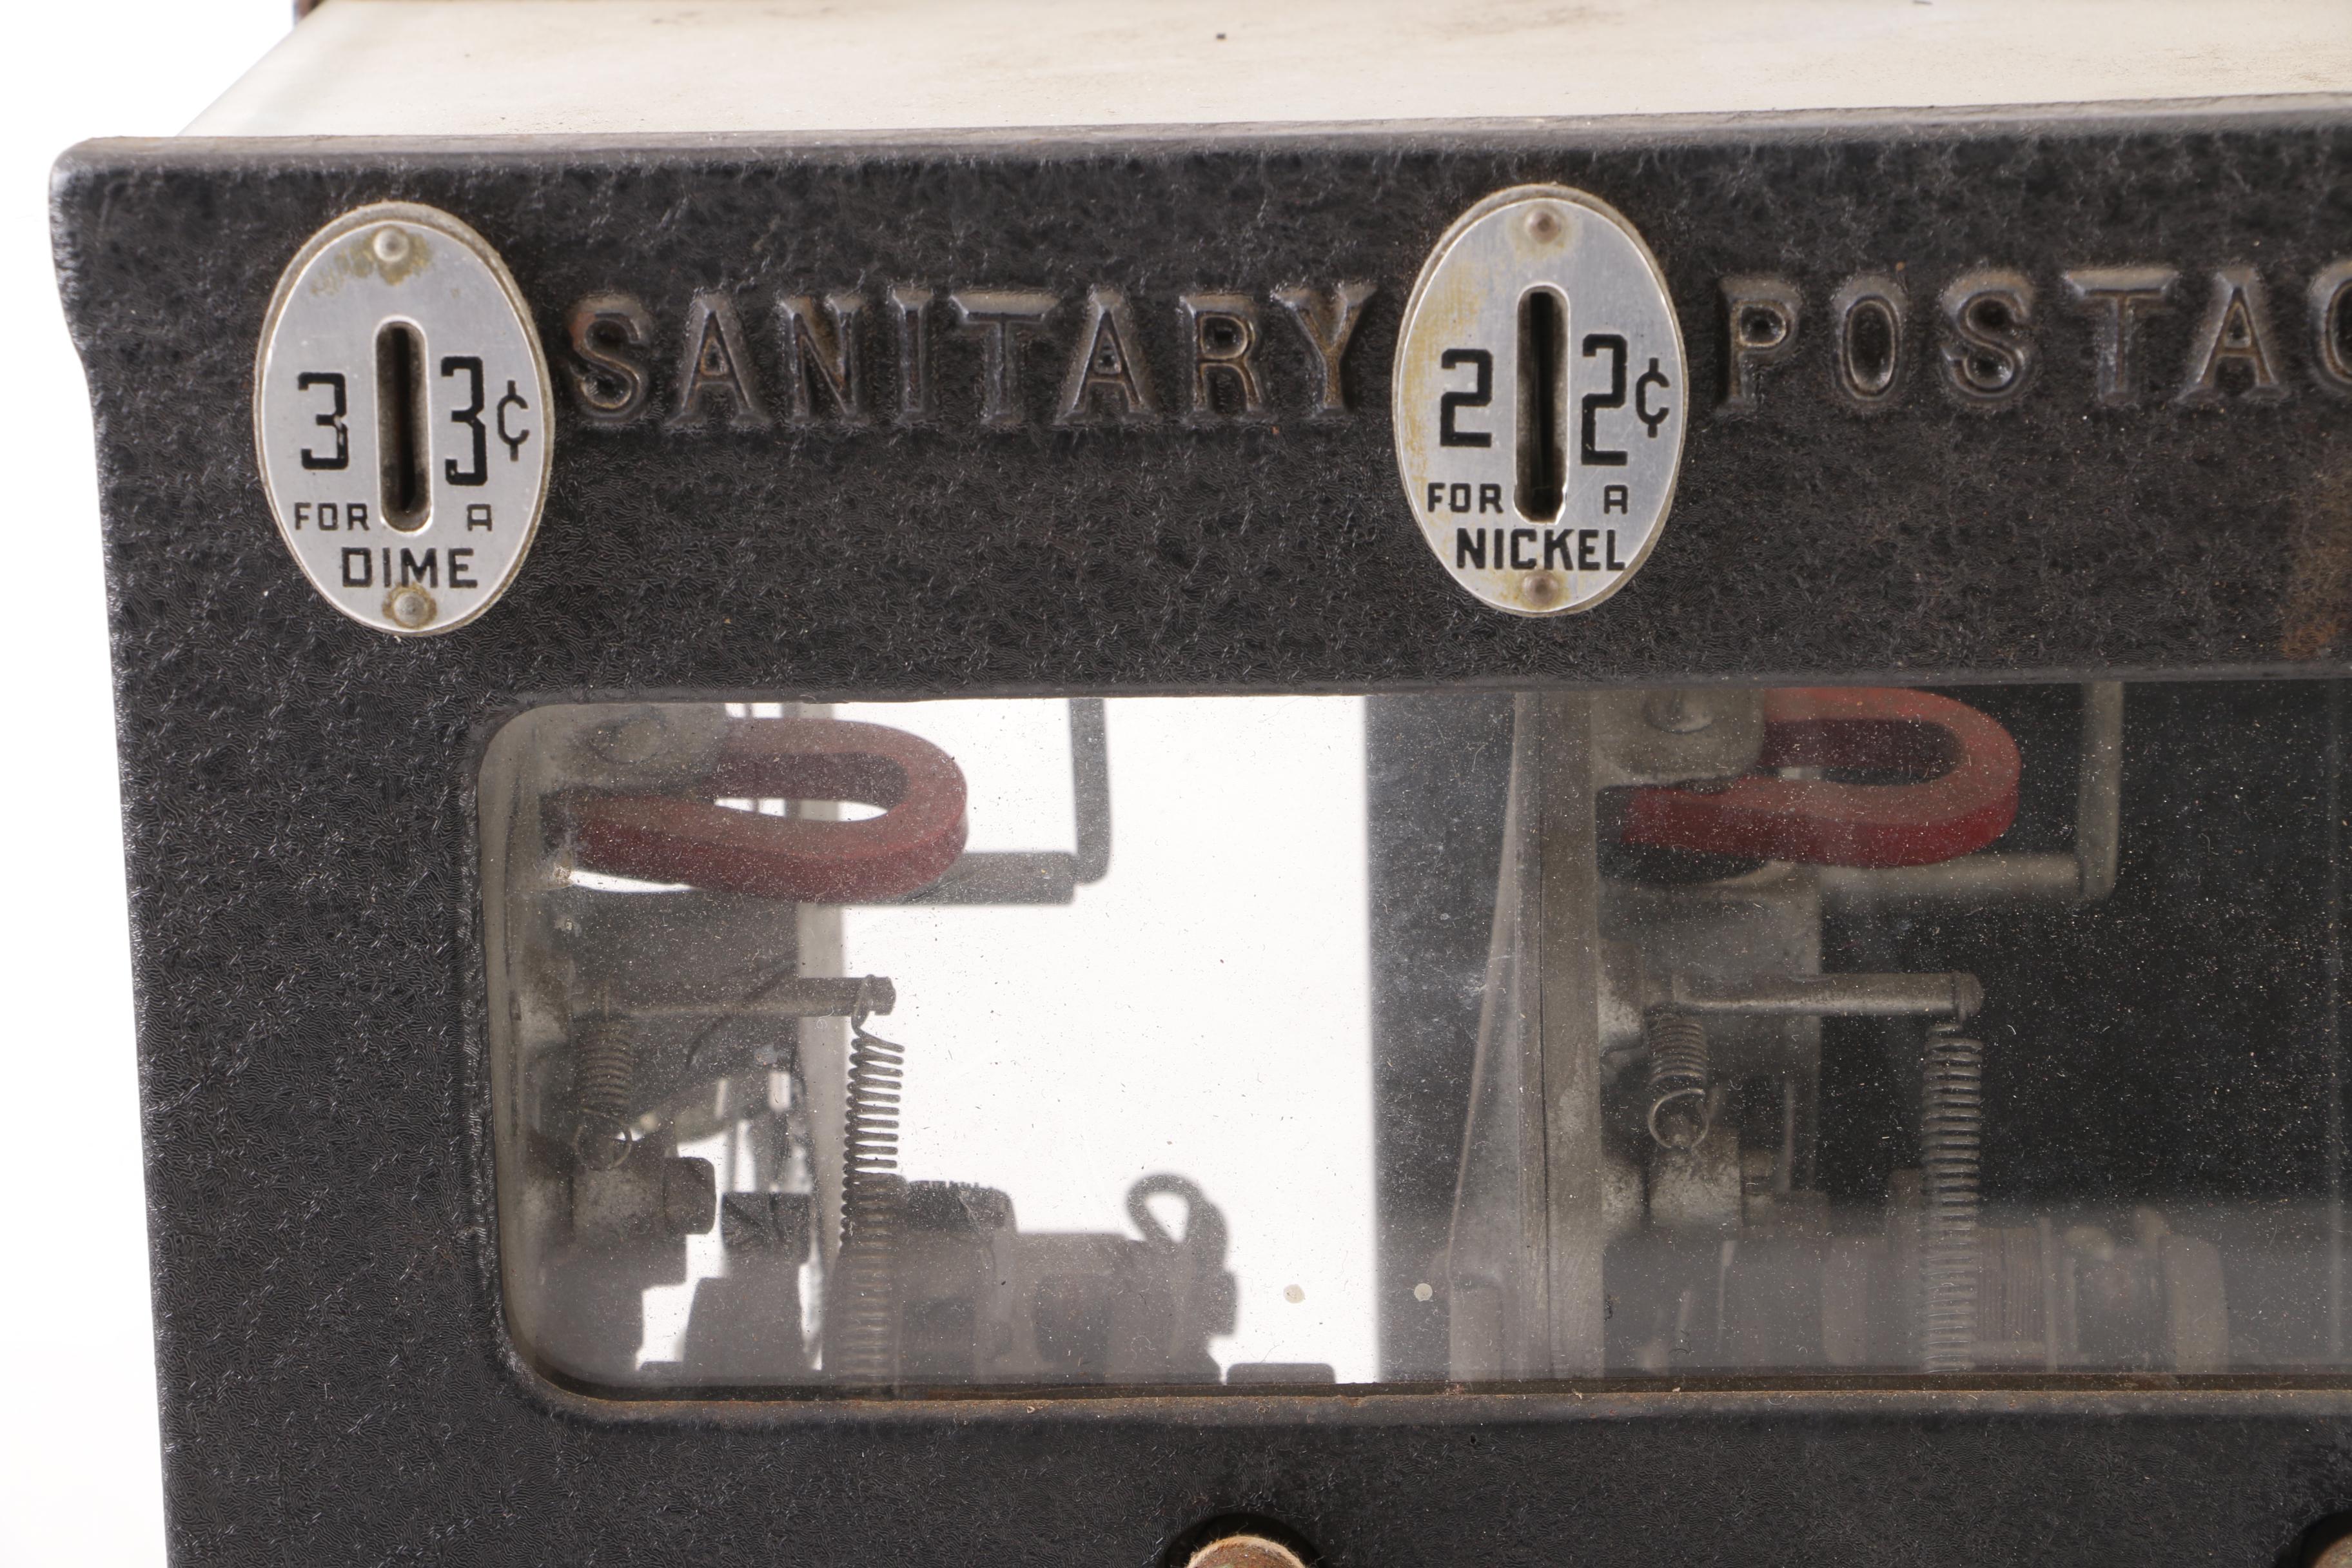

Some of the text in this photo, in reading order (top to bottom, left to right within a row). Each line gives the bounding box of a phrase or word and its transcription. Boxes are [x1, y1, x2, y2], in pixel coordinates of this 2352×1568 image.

[565, 281, 1381, 428] SANITARY
[1440, 348, 1493, 447] 2
[297, 372, 348, 471] 3
[294, 502, 493, 531] FOR A
[1427, 482, 1628, 514] FOR A
[341, 547, 478, 589] DIME
[1456, 527, 1626, 571] NICKEL
